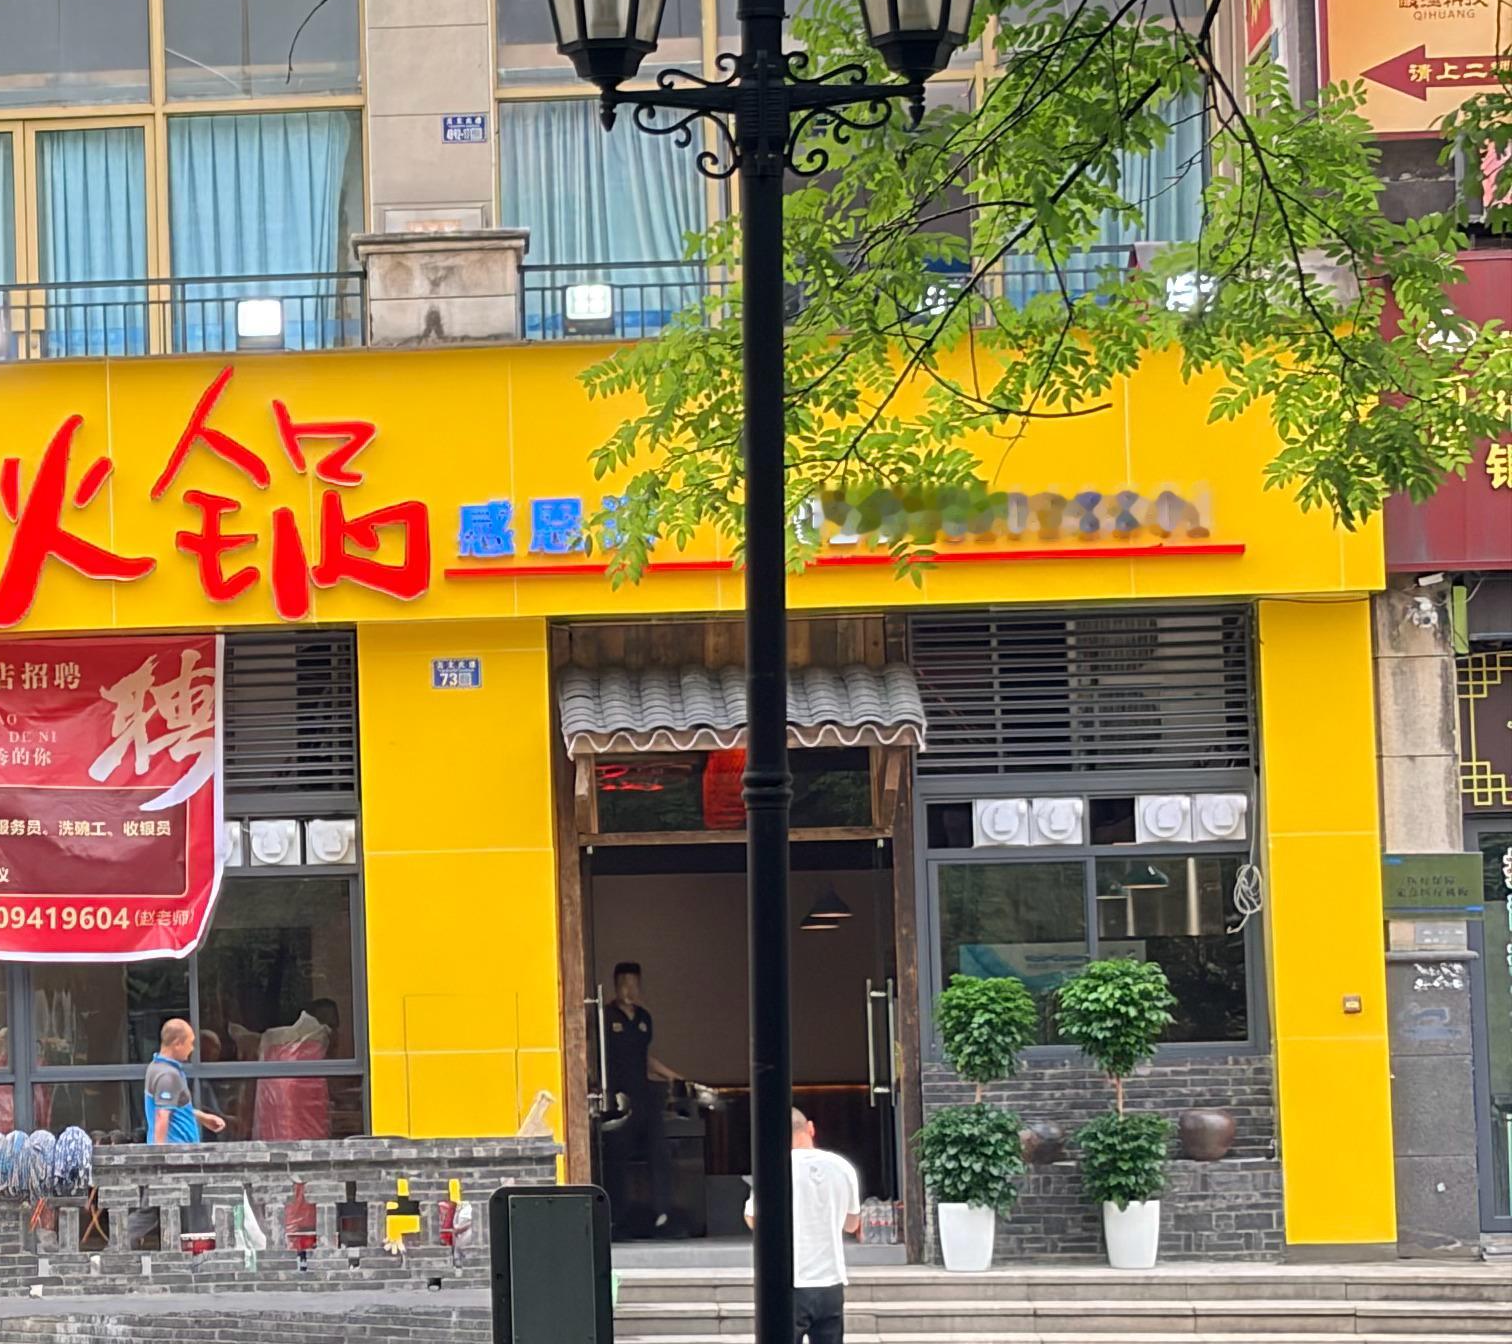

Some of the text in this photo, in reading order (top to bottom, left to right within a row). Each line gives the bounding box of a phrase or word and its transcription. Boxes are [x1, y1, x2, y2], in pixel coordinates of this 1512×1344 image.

[1413, 8, 1476, 21] QIHUANG
[38, 730, 57, 743] NI
[88, 649, 216, 811] 聘
